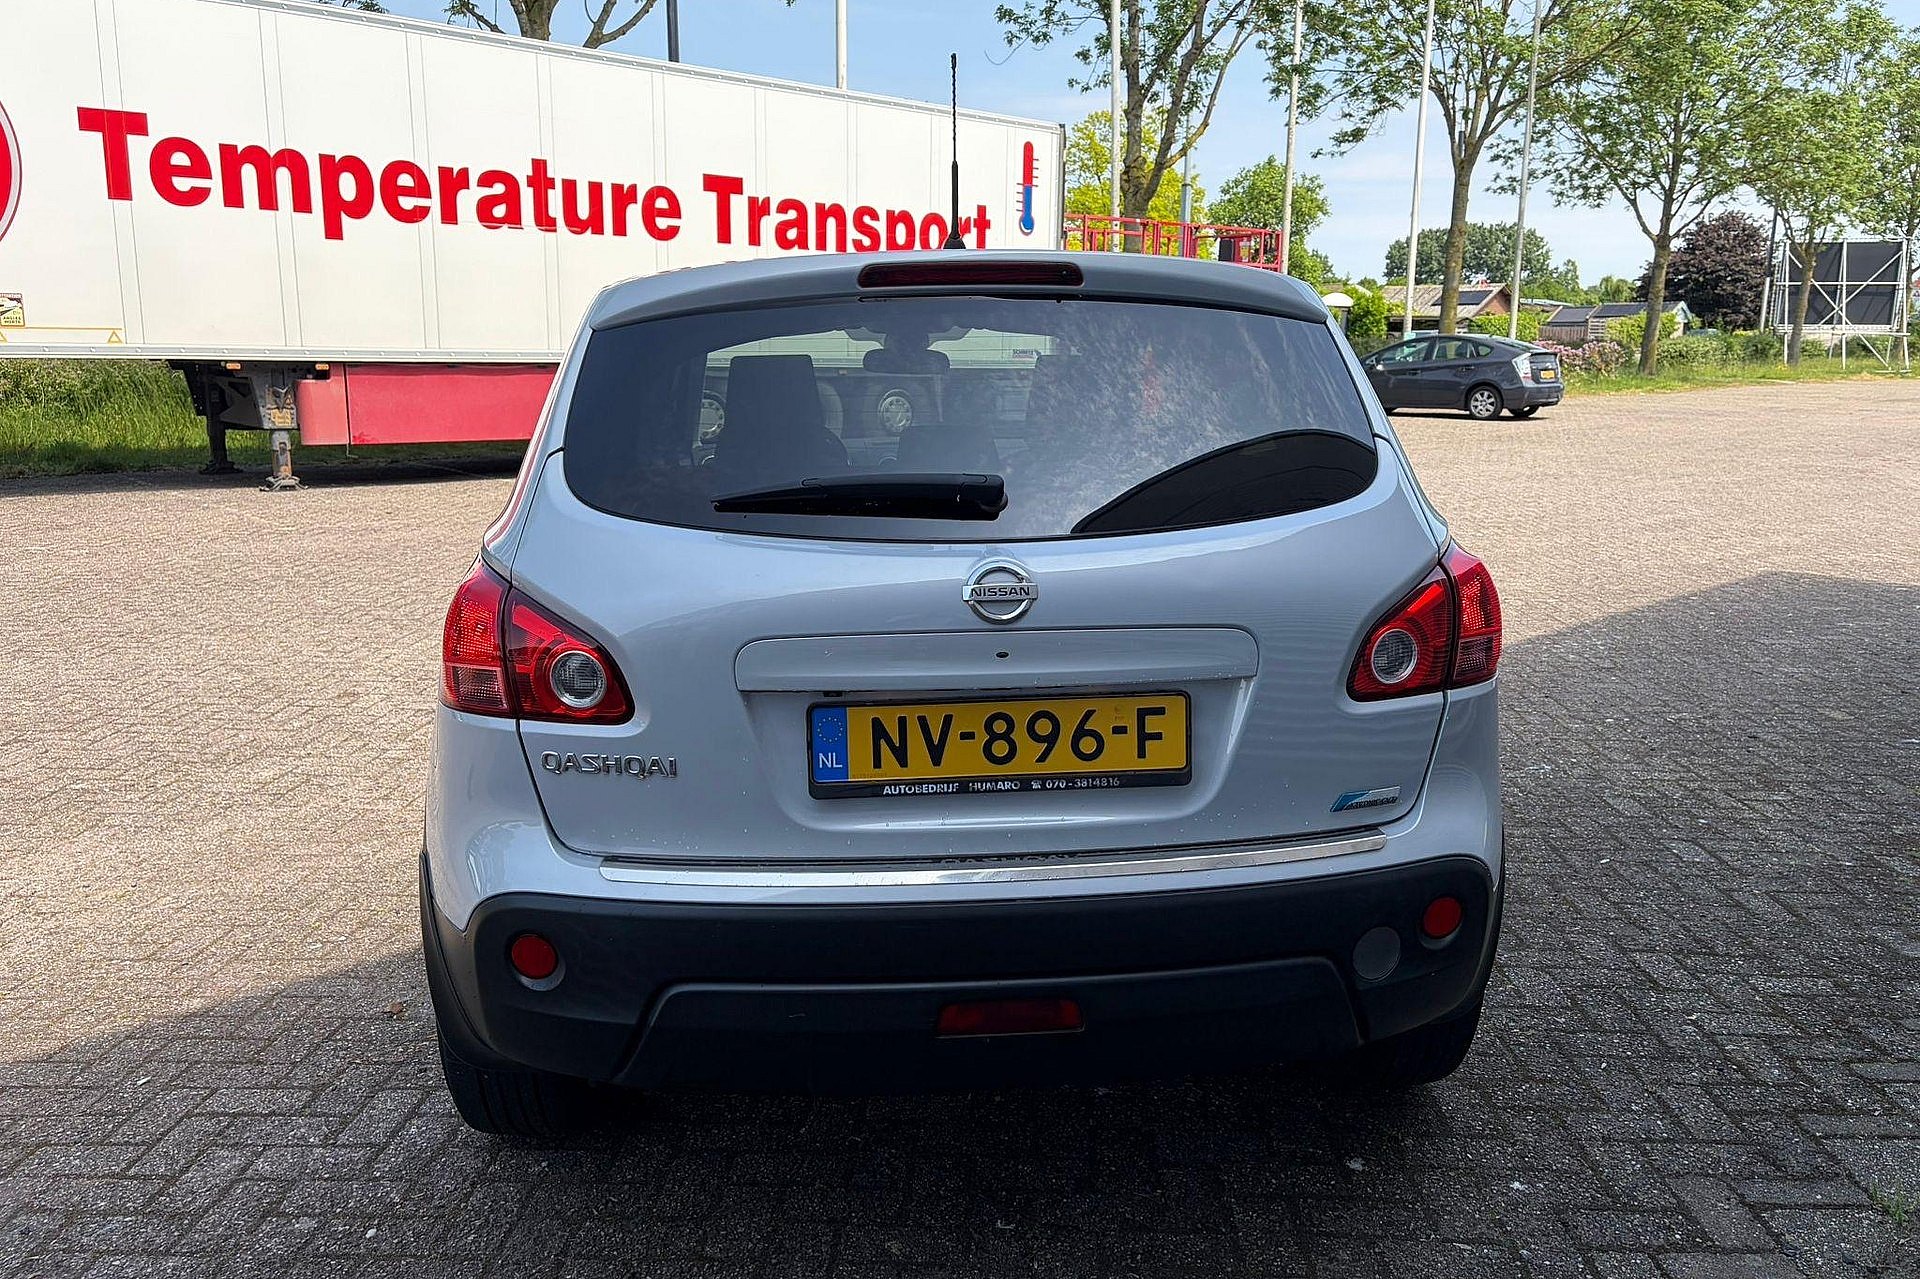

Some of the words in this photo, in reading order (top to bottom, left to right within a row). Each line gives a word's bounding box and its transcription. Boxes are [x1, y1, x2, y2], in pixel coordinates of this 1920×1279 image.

[77, 106, 682, 241] Temperature
[971, 586, 1031, 598] NISSAN
[870, 706, 1167, 769] NV-896-F
[540, 750, 678, 779] QASHQAI
[818, 752, 843, 769] NL
[882, 782, 960, 795] AUTOBEDRIJF
[968, 780, 1021, 792] HUMARO
